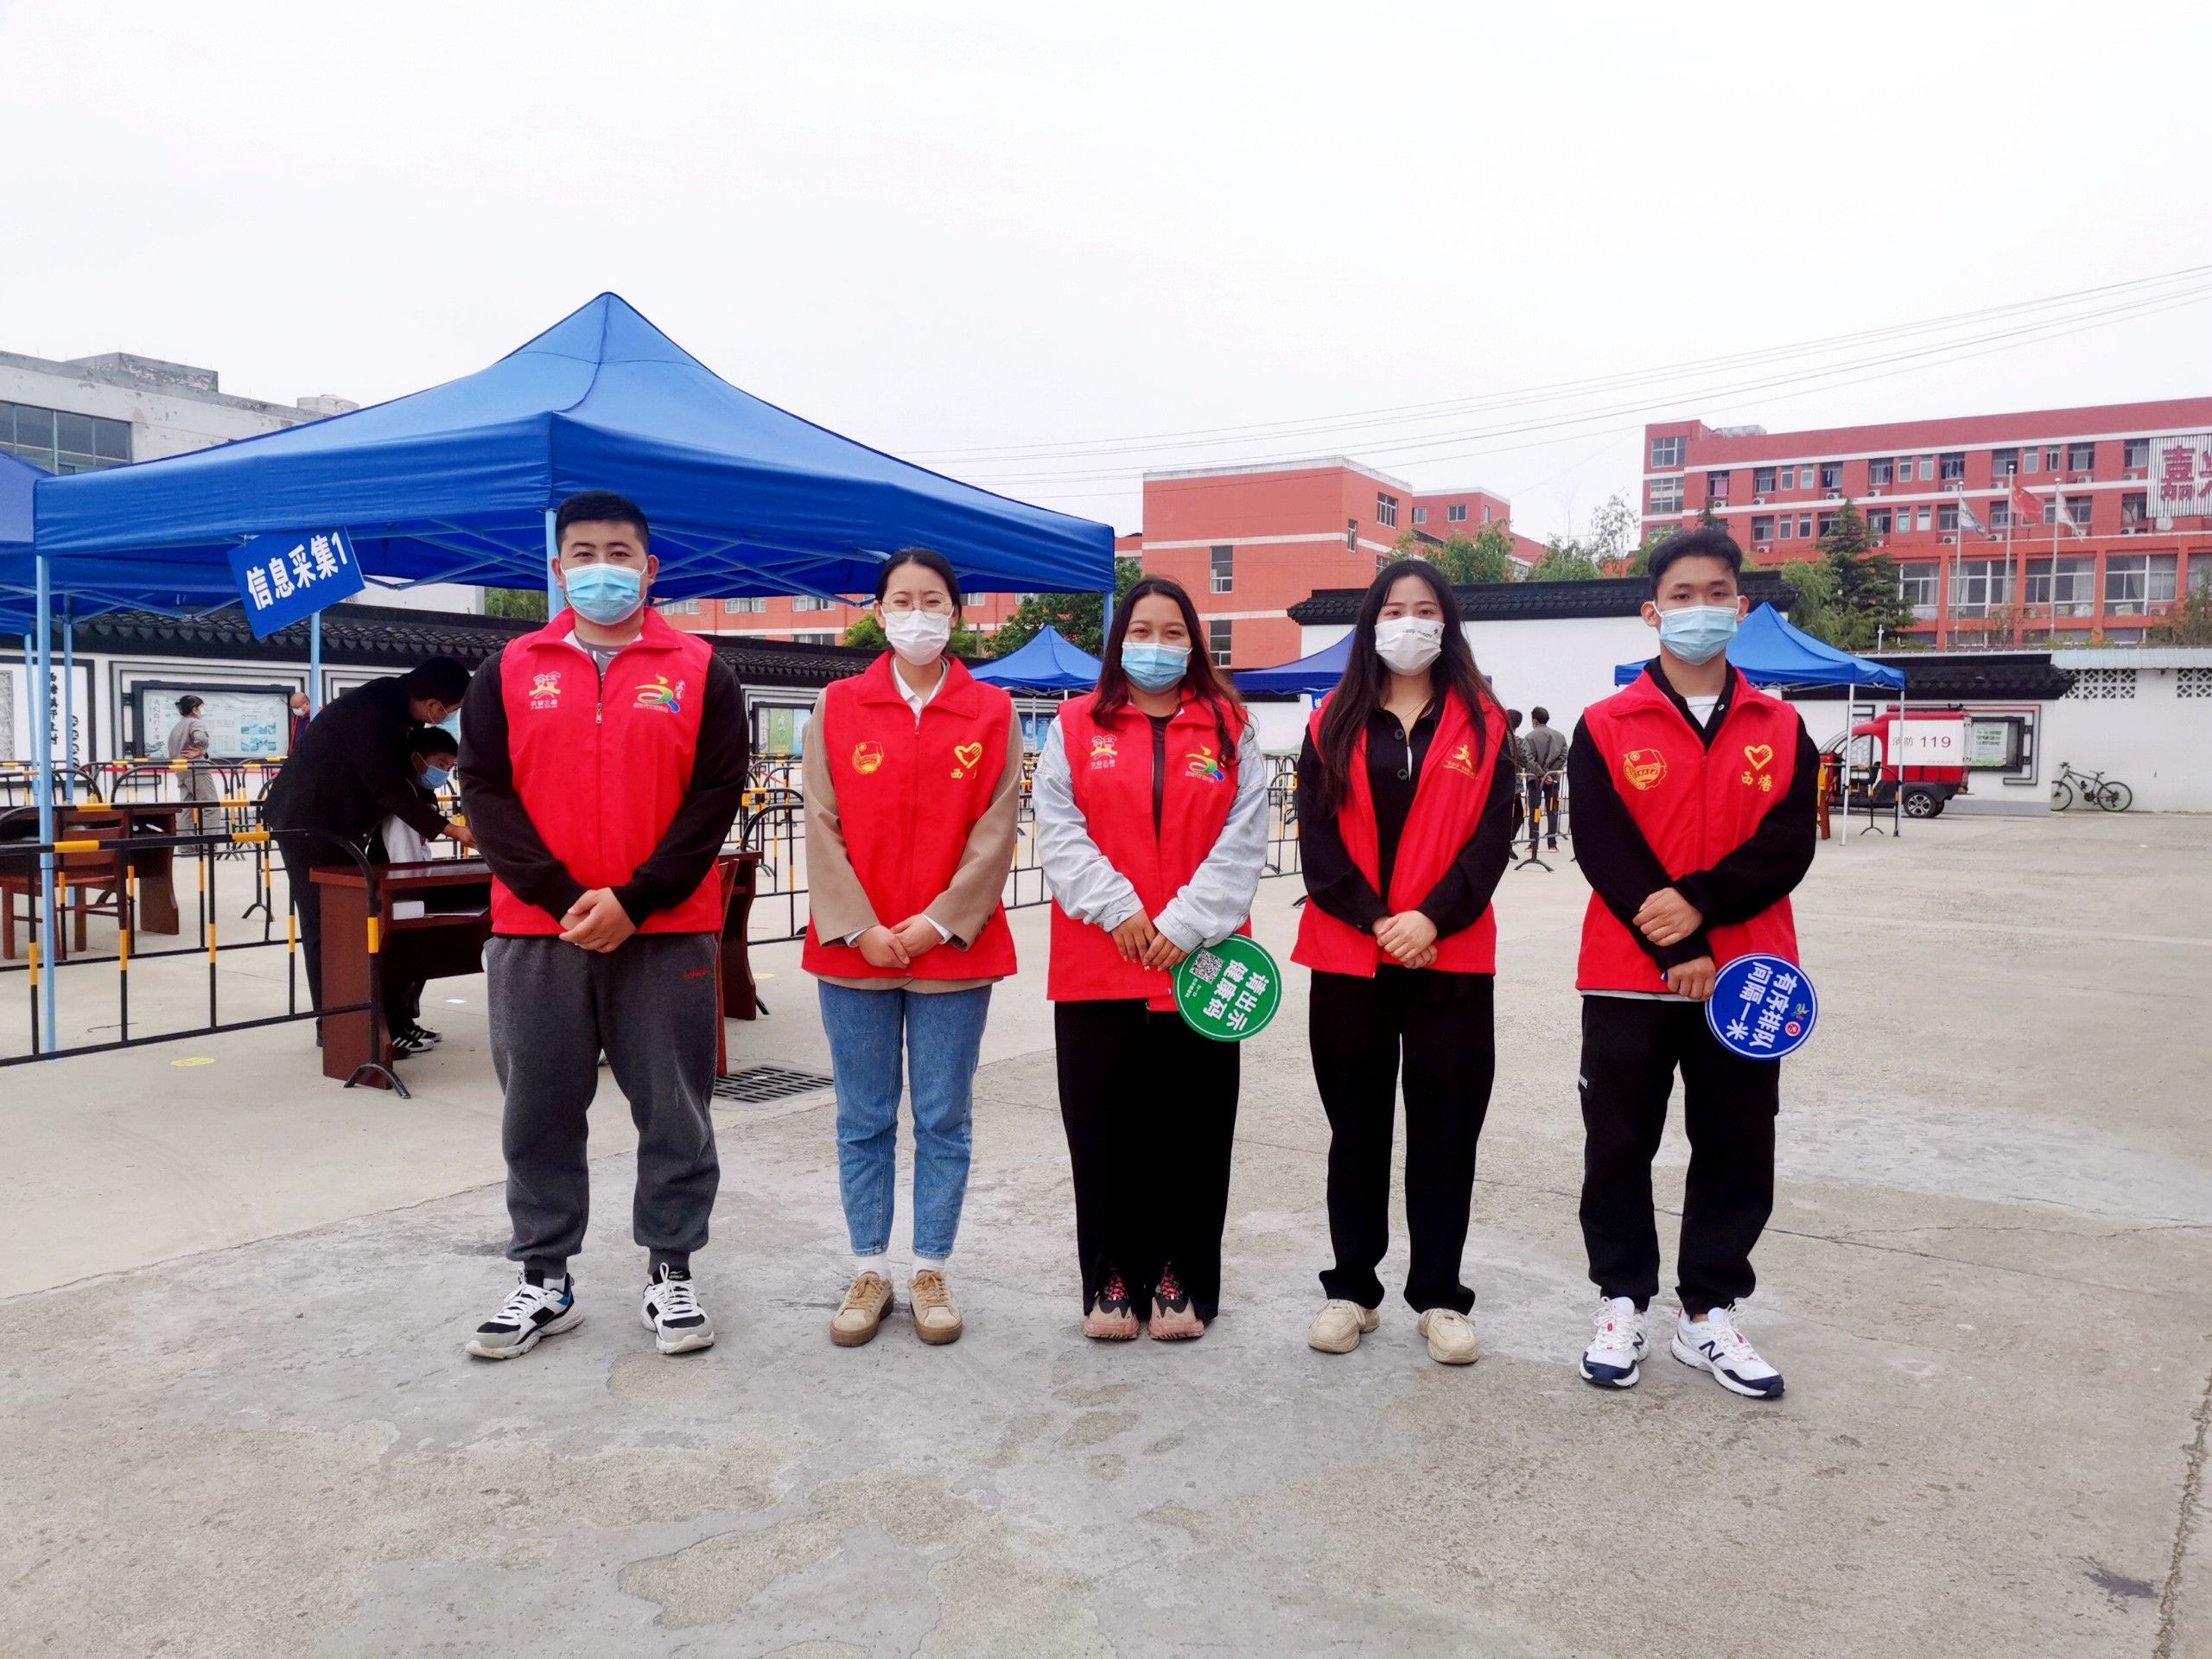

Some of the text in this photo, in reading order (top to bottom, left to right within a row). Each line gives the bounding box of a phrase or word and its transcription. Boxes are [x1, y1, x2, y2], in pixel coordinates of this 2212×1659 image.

[246, 531, 347, 611] 信息采集1
[1921, 735, 1951, 748] 119
[1741, 771, 1773, 792] 西塘
[1202, 959, 1249, 1020] 健康码
[1226, 971, 1270, 1031] 请出示
[1726, 961, 1774, 1040] 间隔一米
[1748, 972, 1798, 1049] 有序排队
